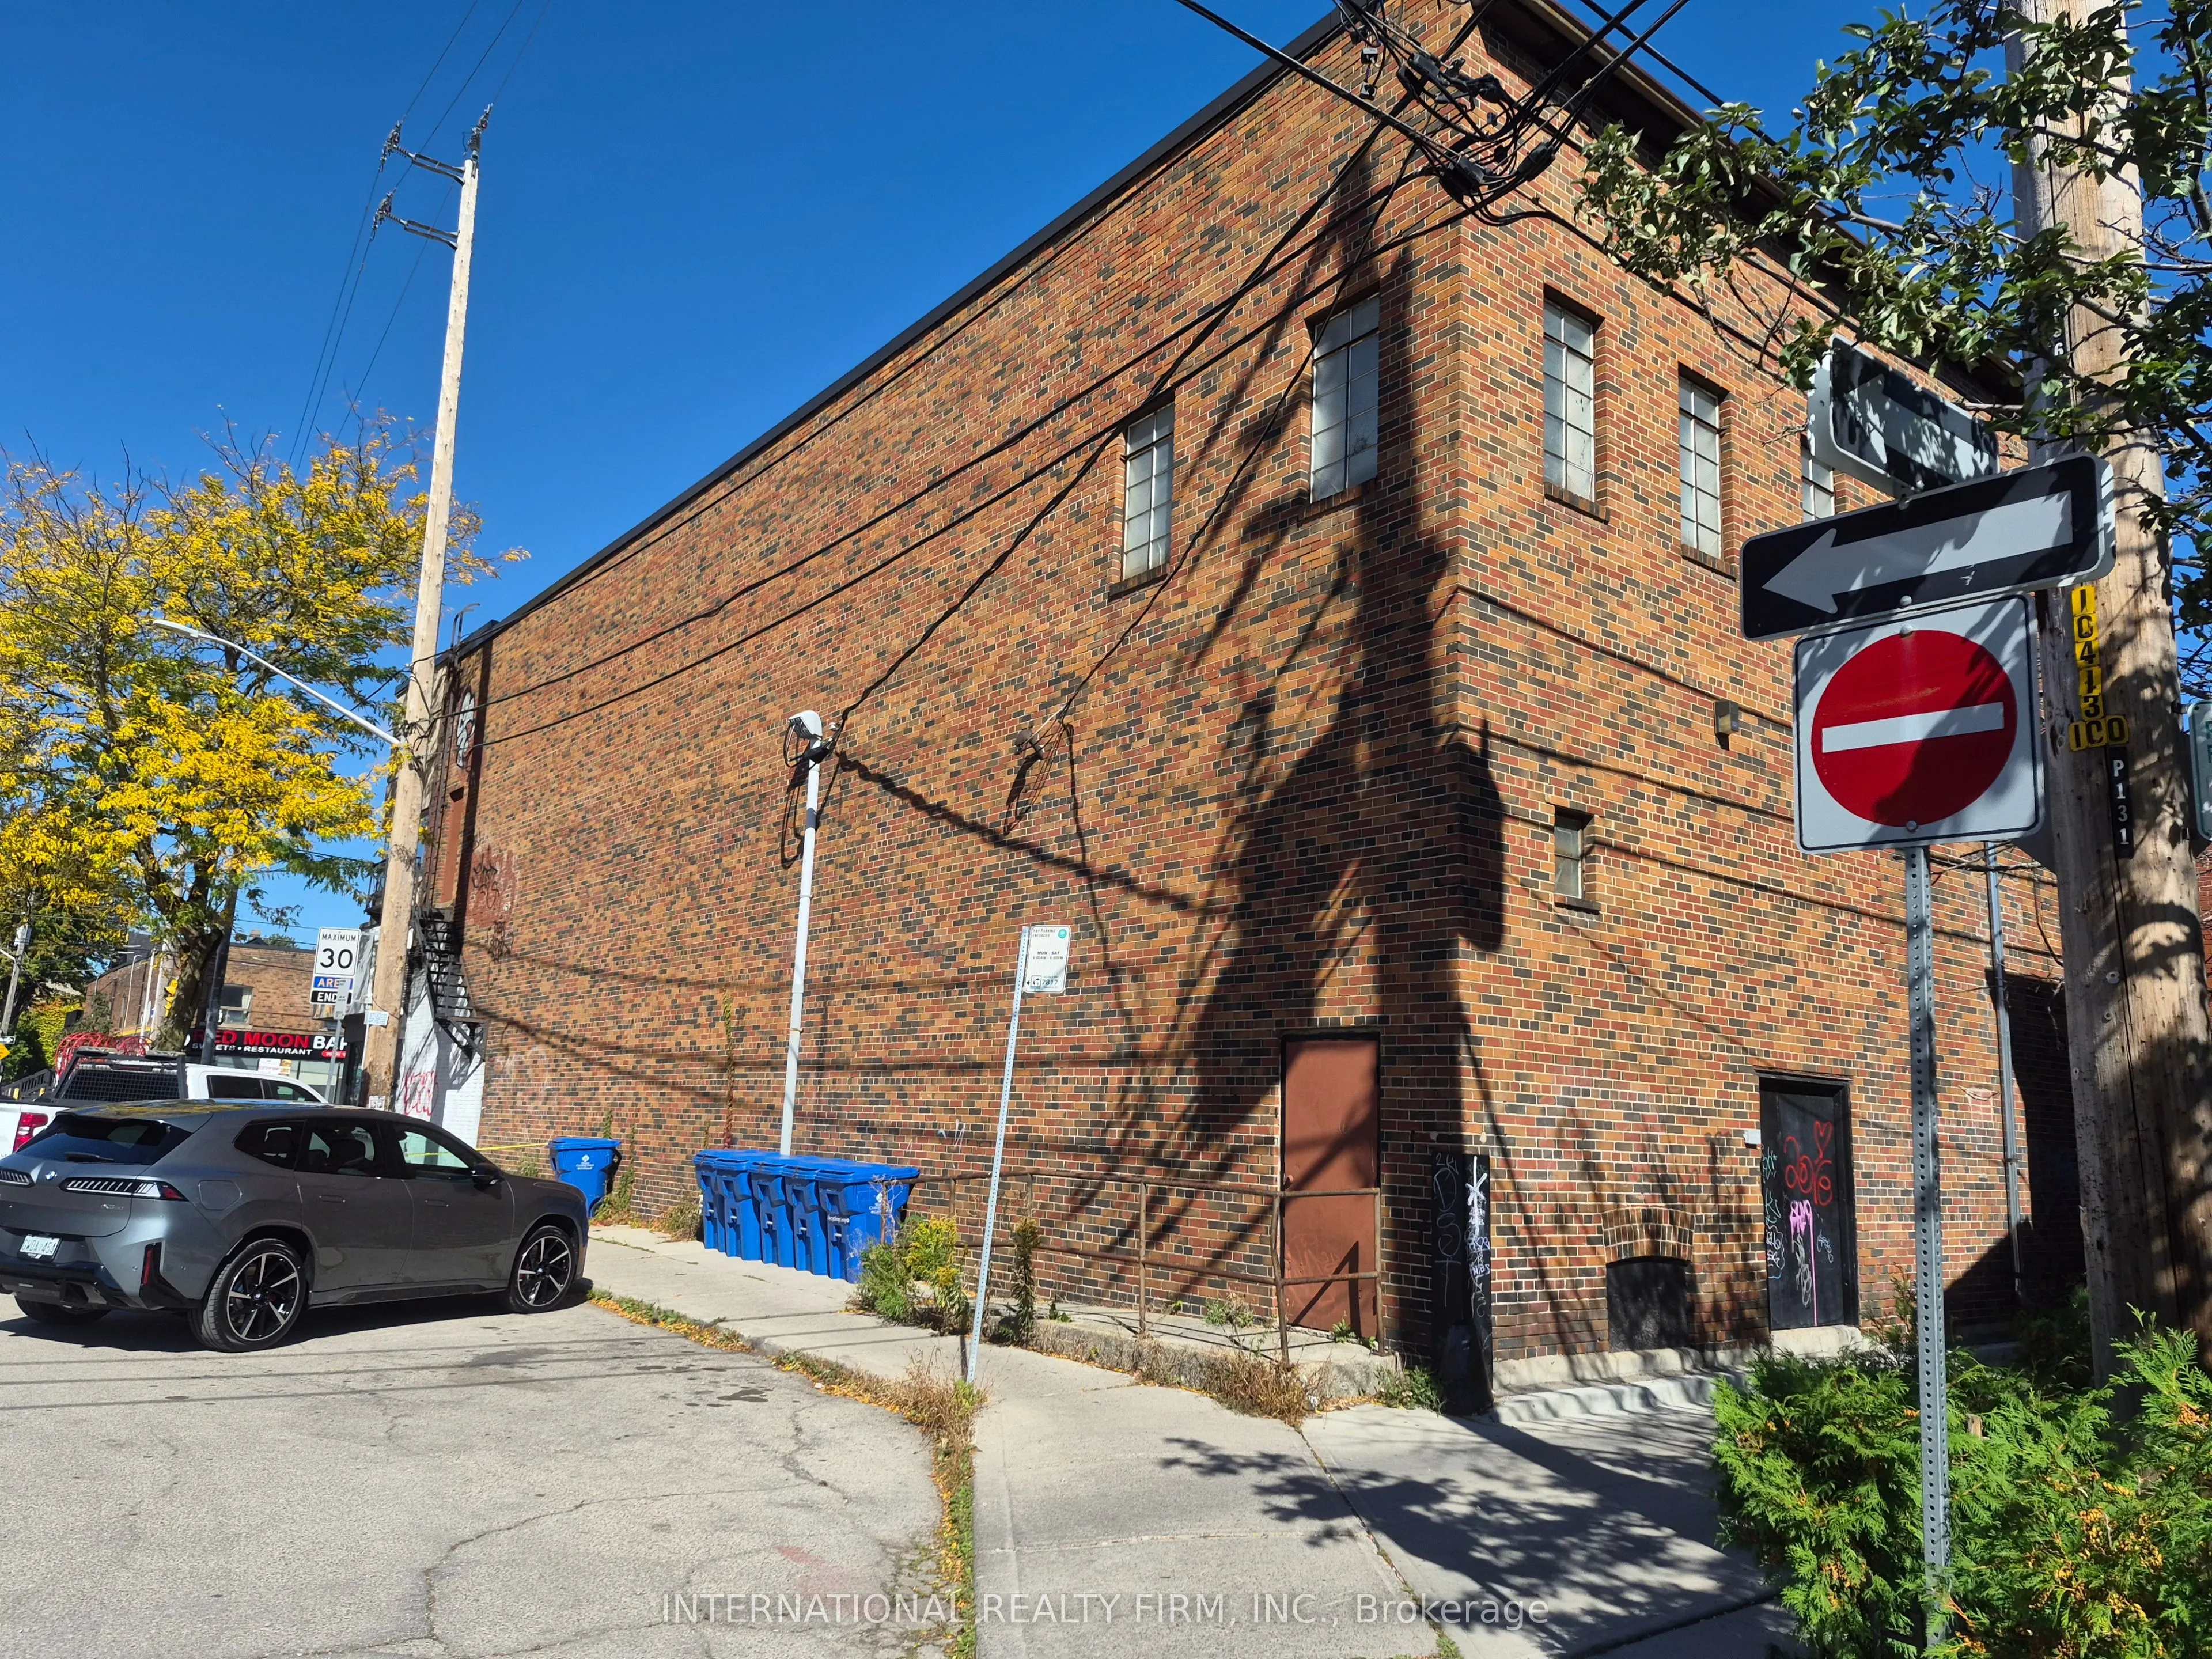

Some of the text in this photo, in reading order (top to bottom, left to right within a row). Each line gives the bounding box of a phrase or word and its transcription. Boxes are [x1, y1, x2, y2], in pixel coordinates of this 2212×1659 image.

[2113, 760, 2130, 845] P131
[321, 933, 357, 942] MAXIMUM
[320, 948, 353, 969] 30
[317, 978, 339, 988] ARE
[243, 1031, 310, 1048] MOON
[243, 1046, 313, 1055] RESTAURANT
[41, 1242, 56, 1253] 454
